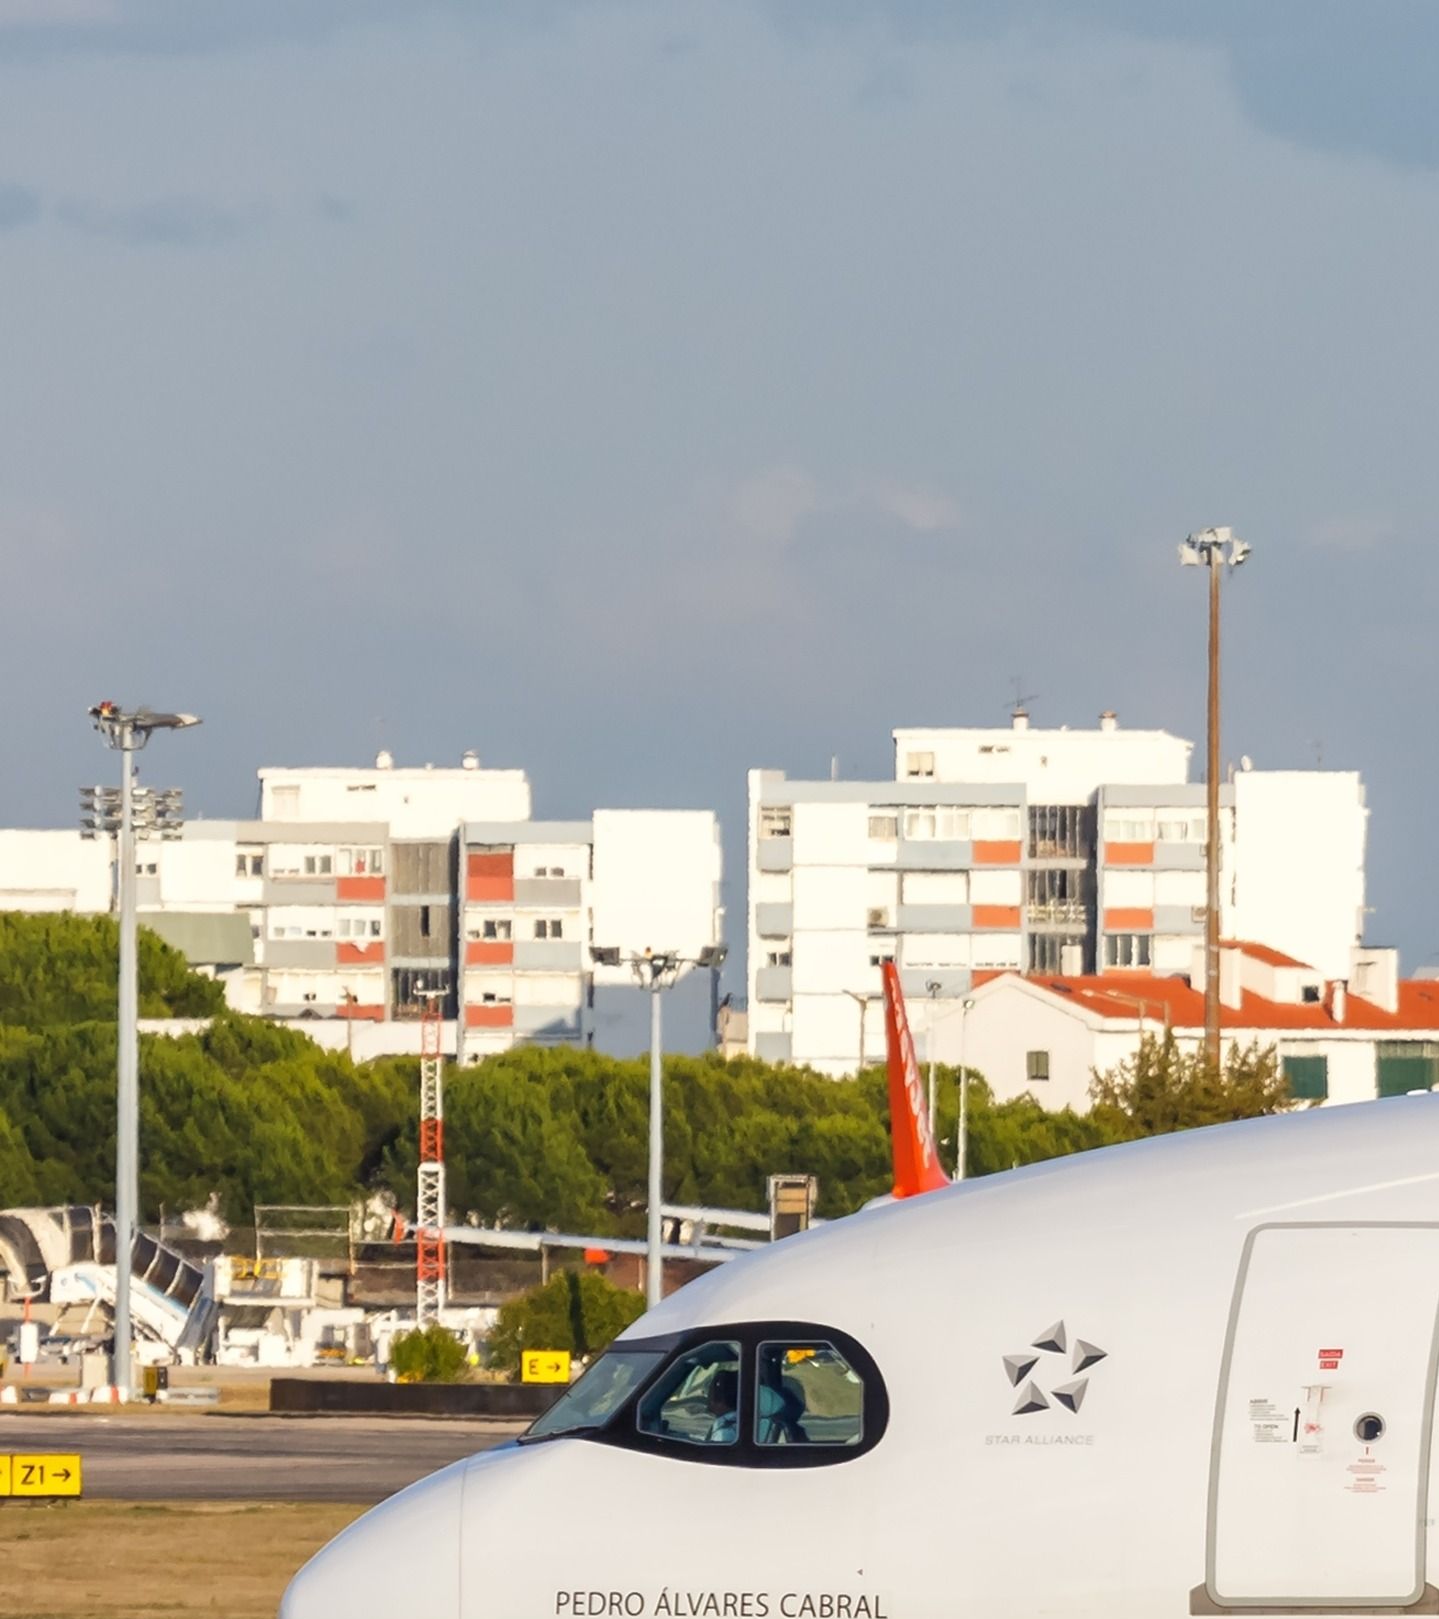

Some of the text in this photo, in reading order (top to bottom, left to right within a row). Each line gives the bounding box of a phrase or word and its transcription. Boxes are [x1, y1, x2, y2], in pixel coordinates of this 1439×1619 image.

[528, 1358, 539, 1375] E
[984, 1435, 1095, 1446] STAR ALLIANCE
[20, 1465, 45, 1486] Z1
[555, 1586, 888, 1619] PEDRO ÁLVARES CABRAL
